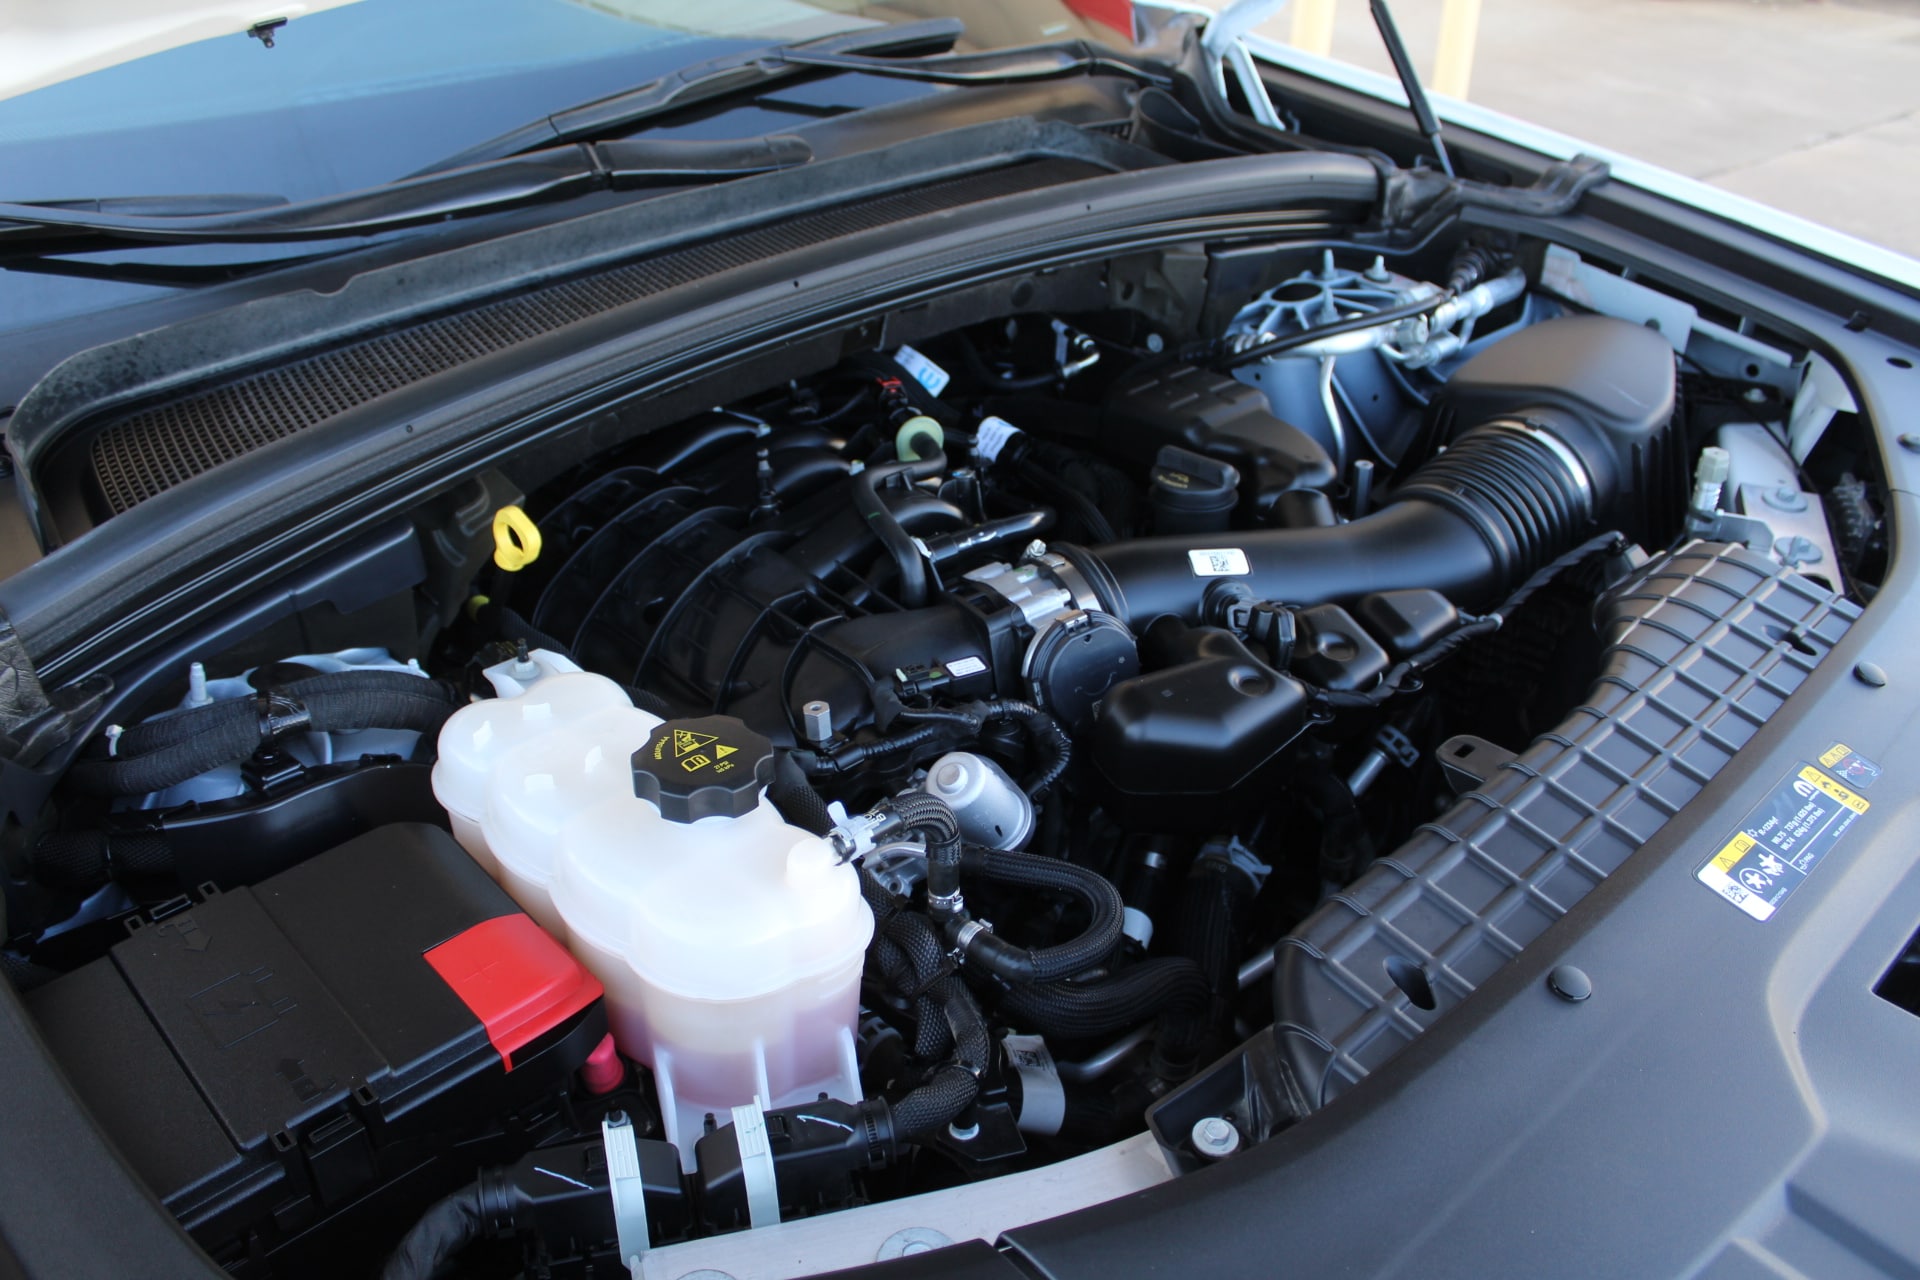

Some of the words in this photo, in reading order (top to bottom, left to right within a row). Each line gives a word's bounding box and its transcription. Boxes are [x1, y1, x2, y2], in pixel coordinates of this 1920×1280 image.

[1758, 815, 1780, 836] R-1234yf
[1771, 830, 1787, 845] WL75
[1784, 818, 1799, 832] 737g
[1780, 836, 1796, 851] WL74
